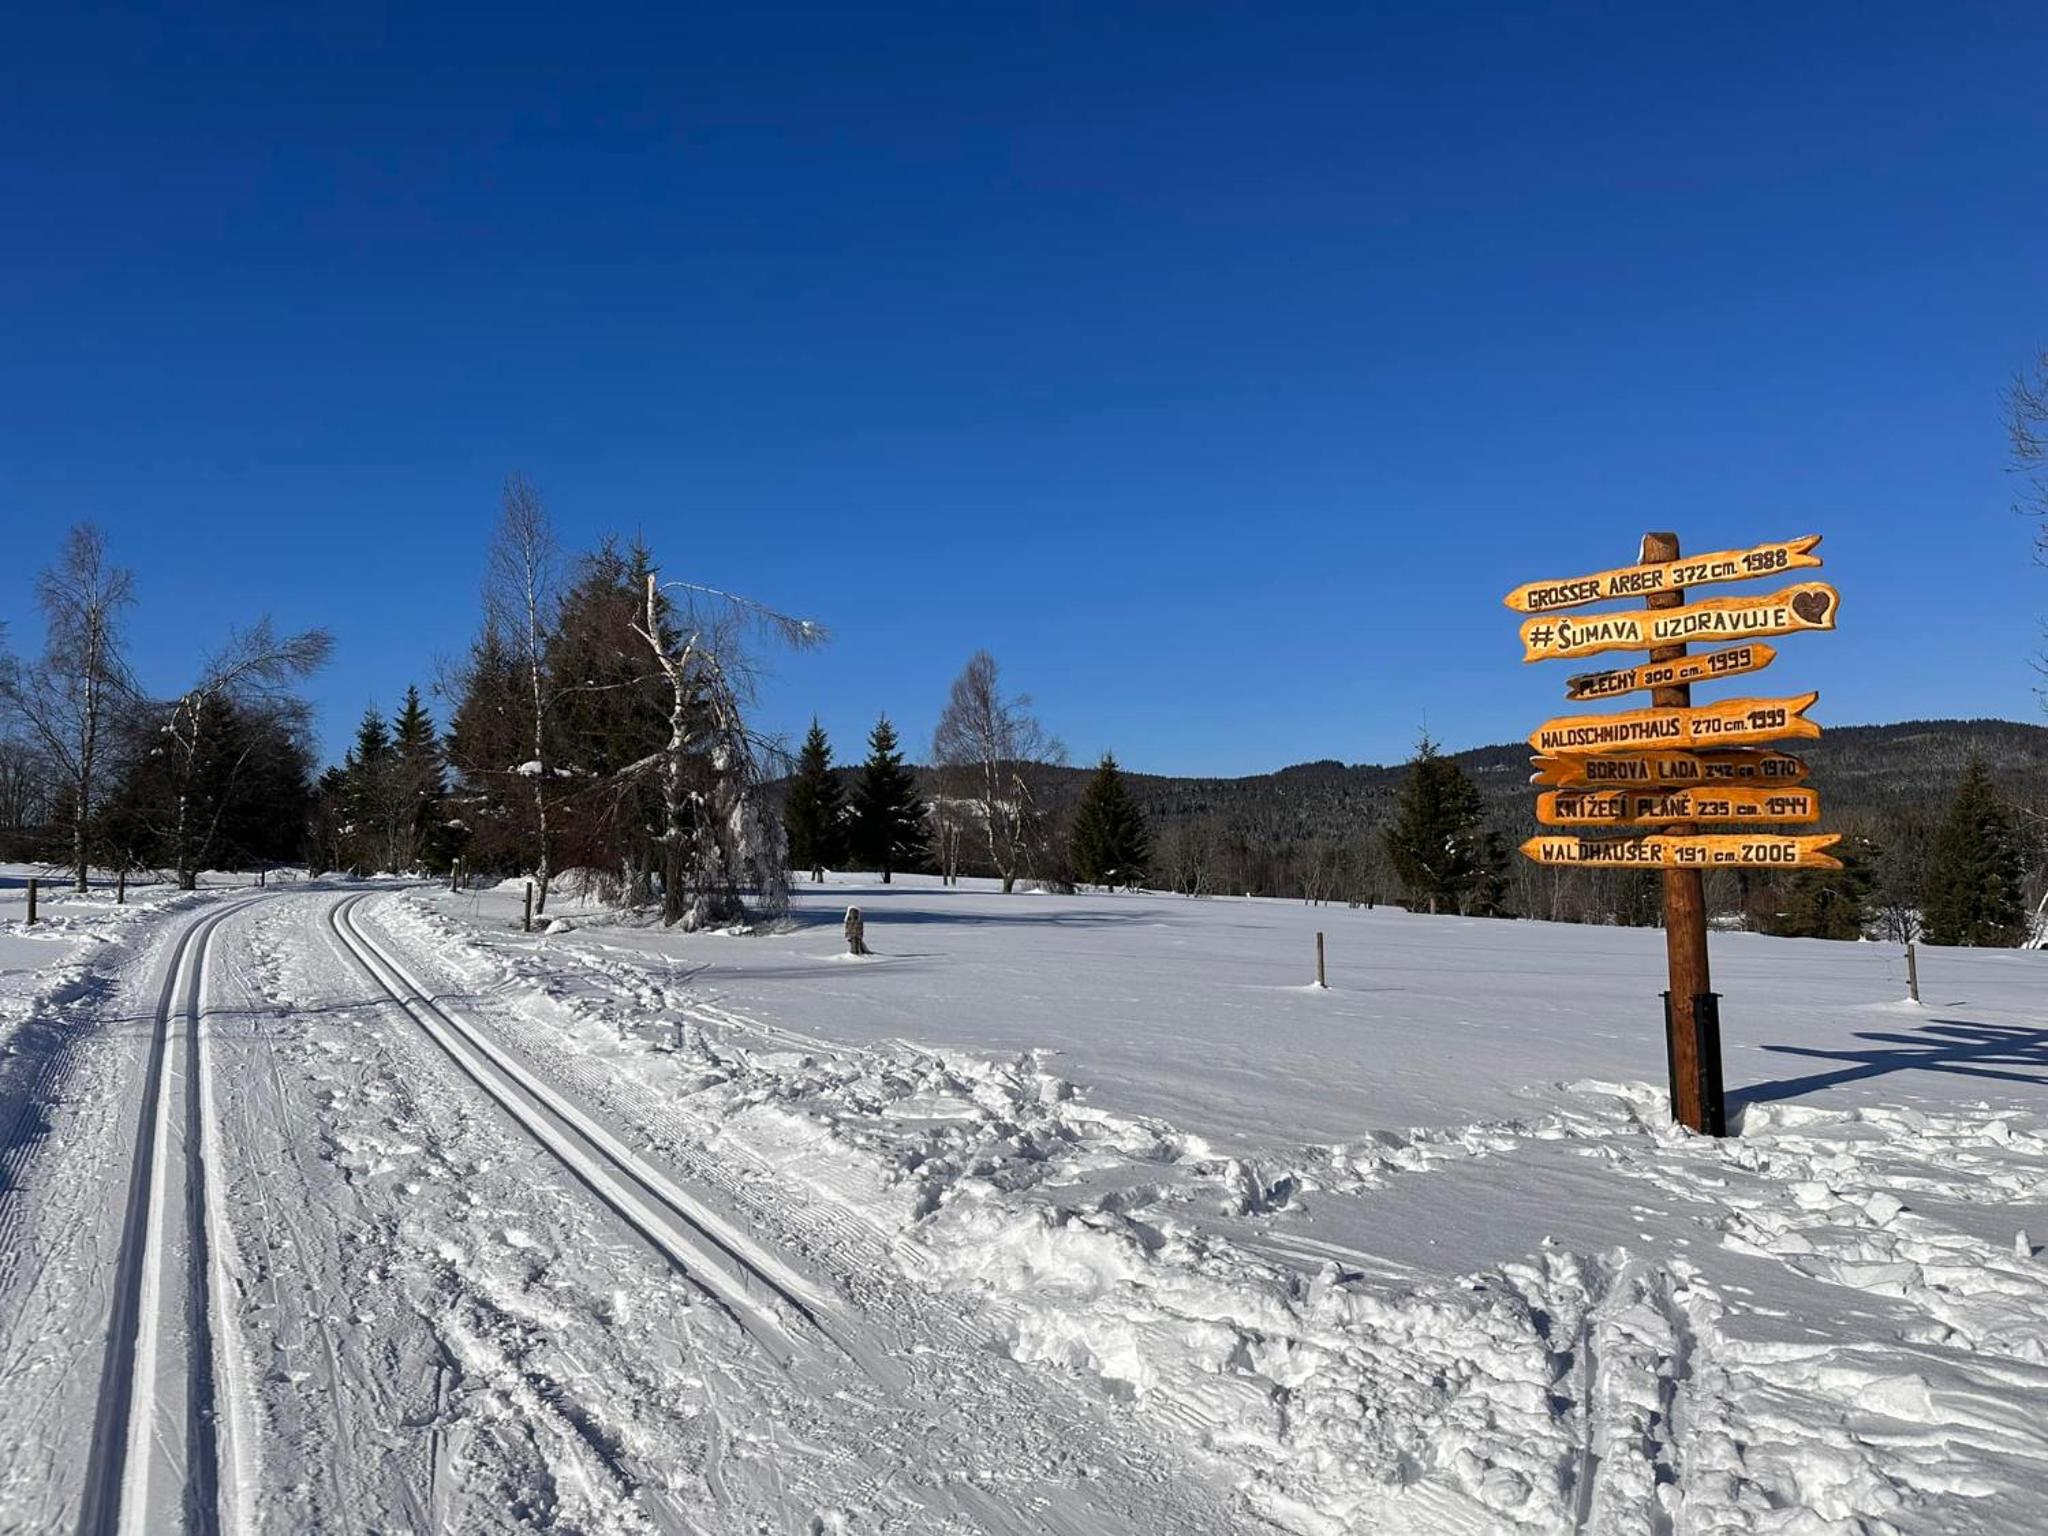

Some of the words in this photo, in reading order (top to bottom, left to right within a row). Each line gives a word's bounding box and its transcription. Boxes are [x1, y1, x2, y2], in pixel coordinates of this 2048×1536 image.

[1527, 580, 1600, 609] GROSSER
[1609, 570, 1663, 595] ARBER
[1673, 563, 1708, 584] 372
[1711, 561, 1738, 578] cm.
[1742, 548, 1788, 572] 1988
[1530, 619, 1639, 649] #ŠUMAVA
[1655, 608, 1786, 638] UZDRAVUJE
[1579, 668, 1637, 696] PLECHÝ
[1645, 669, 1673, 685] 300
[1680, 664, 1703, 677] cm.
[1707, 648, 1751, 672] 1999
[1692, 719, 1721, 734] 270
[1724, 720, 1748, 732] cm.
[1747, 708, 1785, 729] 1999
[1586, 757, 1648, 779] BOROVÁ
[1658, 761, 1698, 778] LADA
[1704, 765, 1733, 777] 242
[1761, 759, 1796, 776] 1970
[1555, 794, 1626, 818] KNÍŽECÍ
[1698, 801, 1729, 816] 235
[1765, 796, 1807, 815] 1944
[1675, 846, 1706, 862] 191
[1714, 851, 1738, 862] cm.
[1741, 844, 1796, 862] 2006
